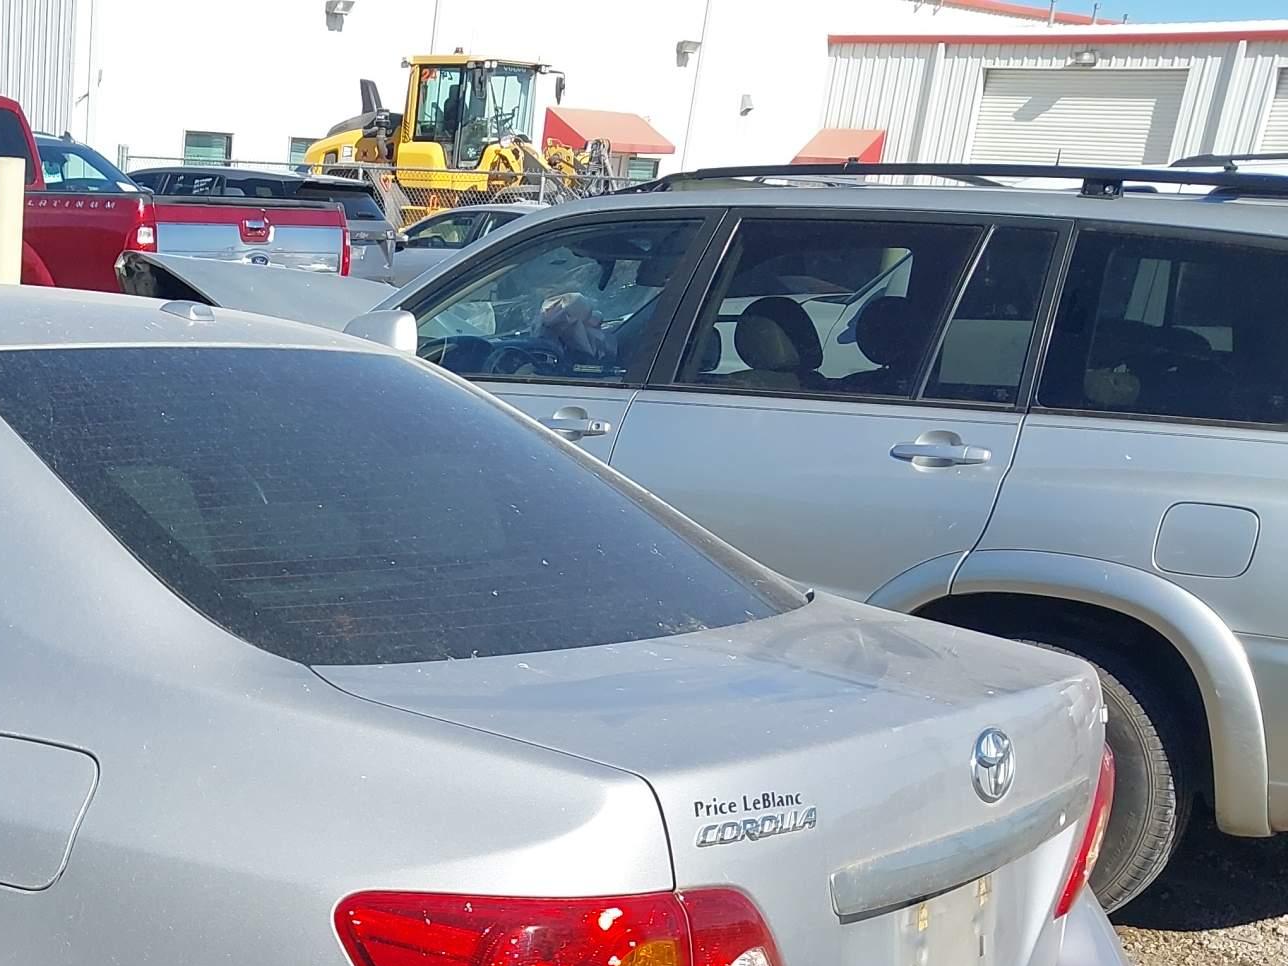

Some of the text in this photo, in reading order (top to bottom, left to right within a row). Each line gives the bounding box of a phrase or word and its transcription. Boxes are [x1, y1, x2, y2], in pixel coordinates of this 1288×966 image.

[27, 199, 116, 209] LATINUM
[694, 791, 803, 818] Price LeBlanc
[695, 806, 817, 847] COROLLA
